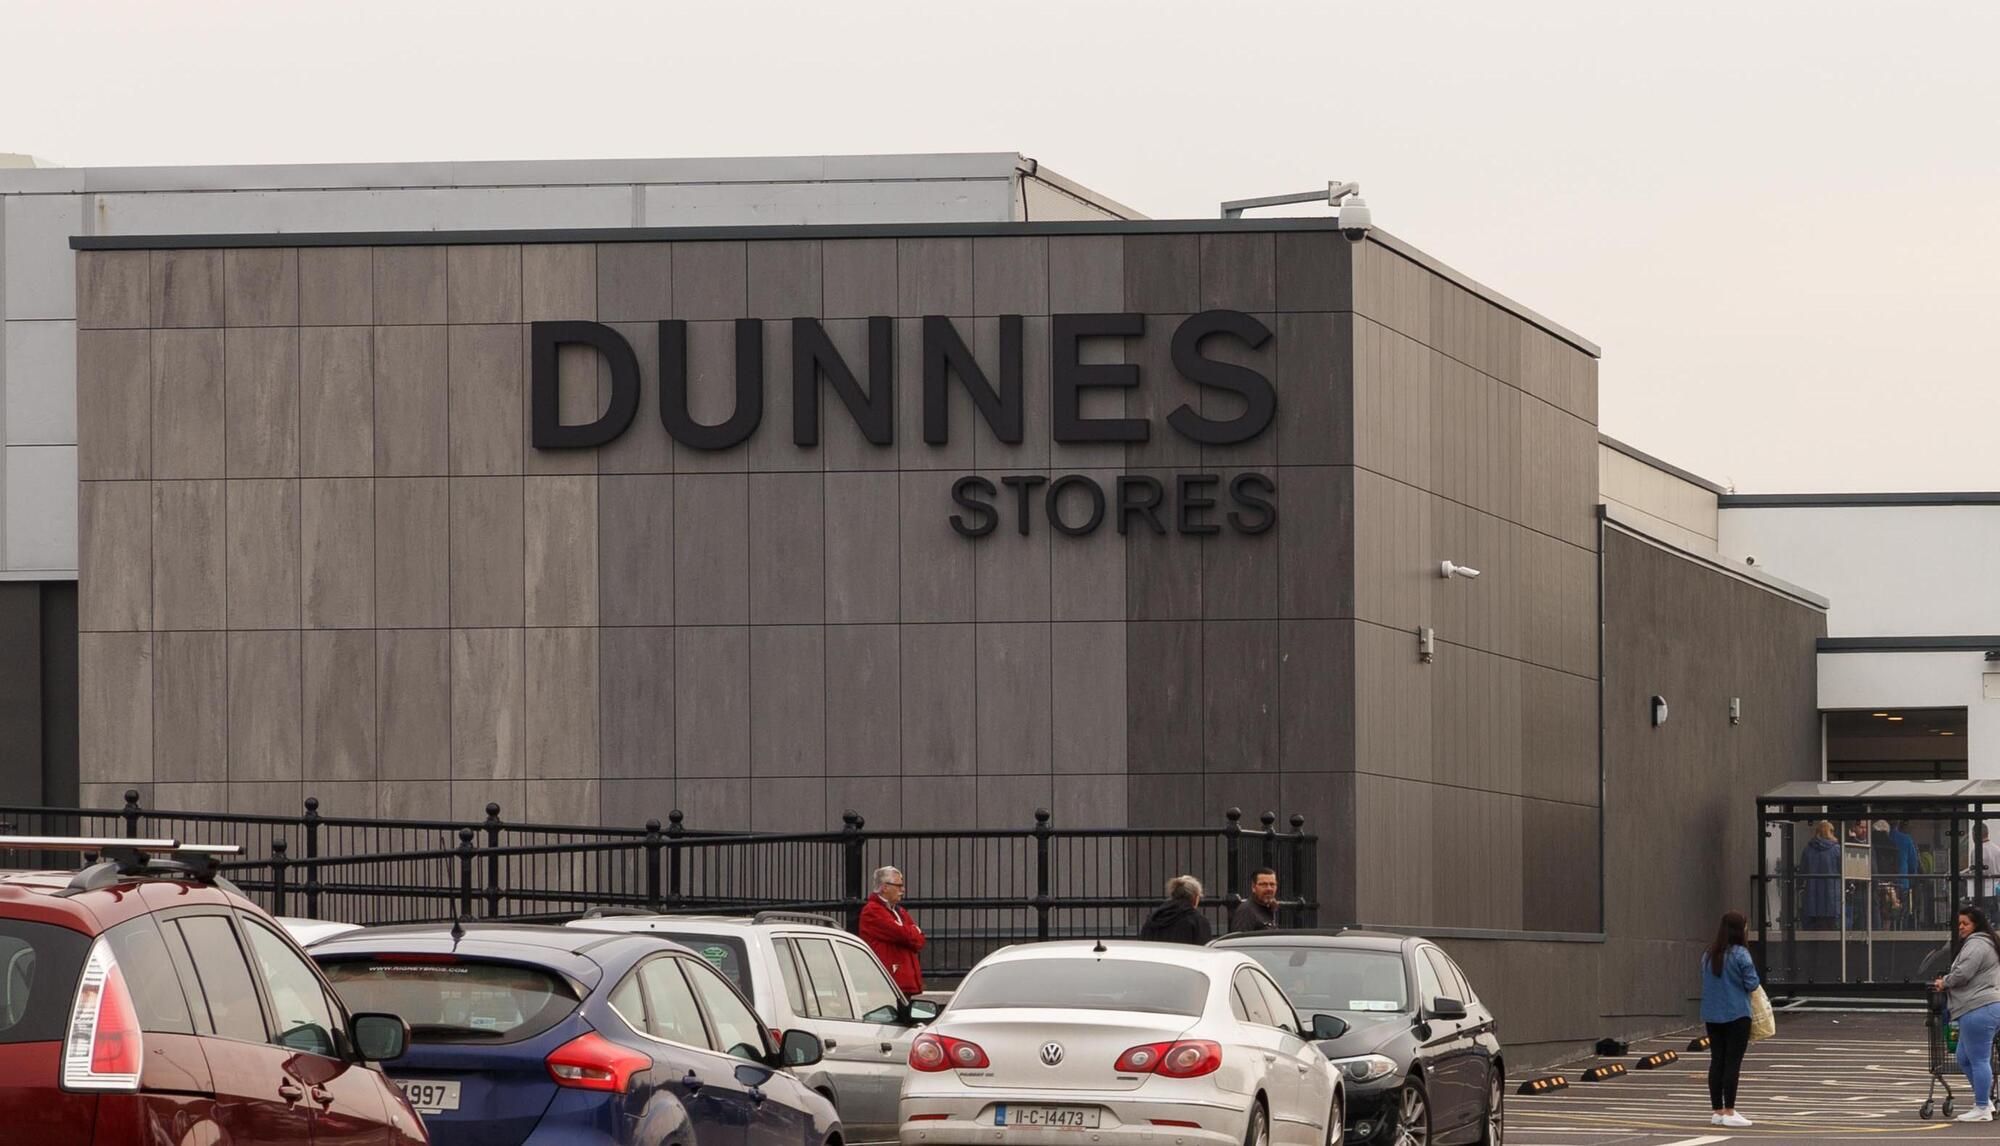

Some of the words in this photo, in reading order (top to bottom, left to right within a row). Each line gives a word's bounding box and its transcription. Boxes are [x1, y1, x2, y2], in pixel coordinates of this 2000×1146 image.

[531, 309, 1278, 450] DUNNES
[949, 472, 1277, 537] STORES
[1015, 1110, 1084, 1126] 11-C-14473
